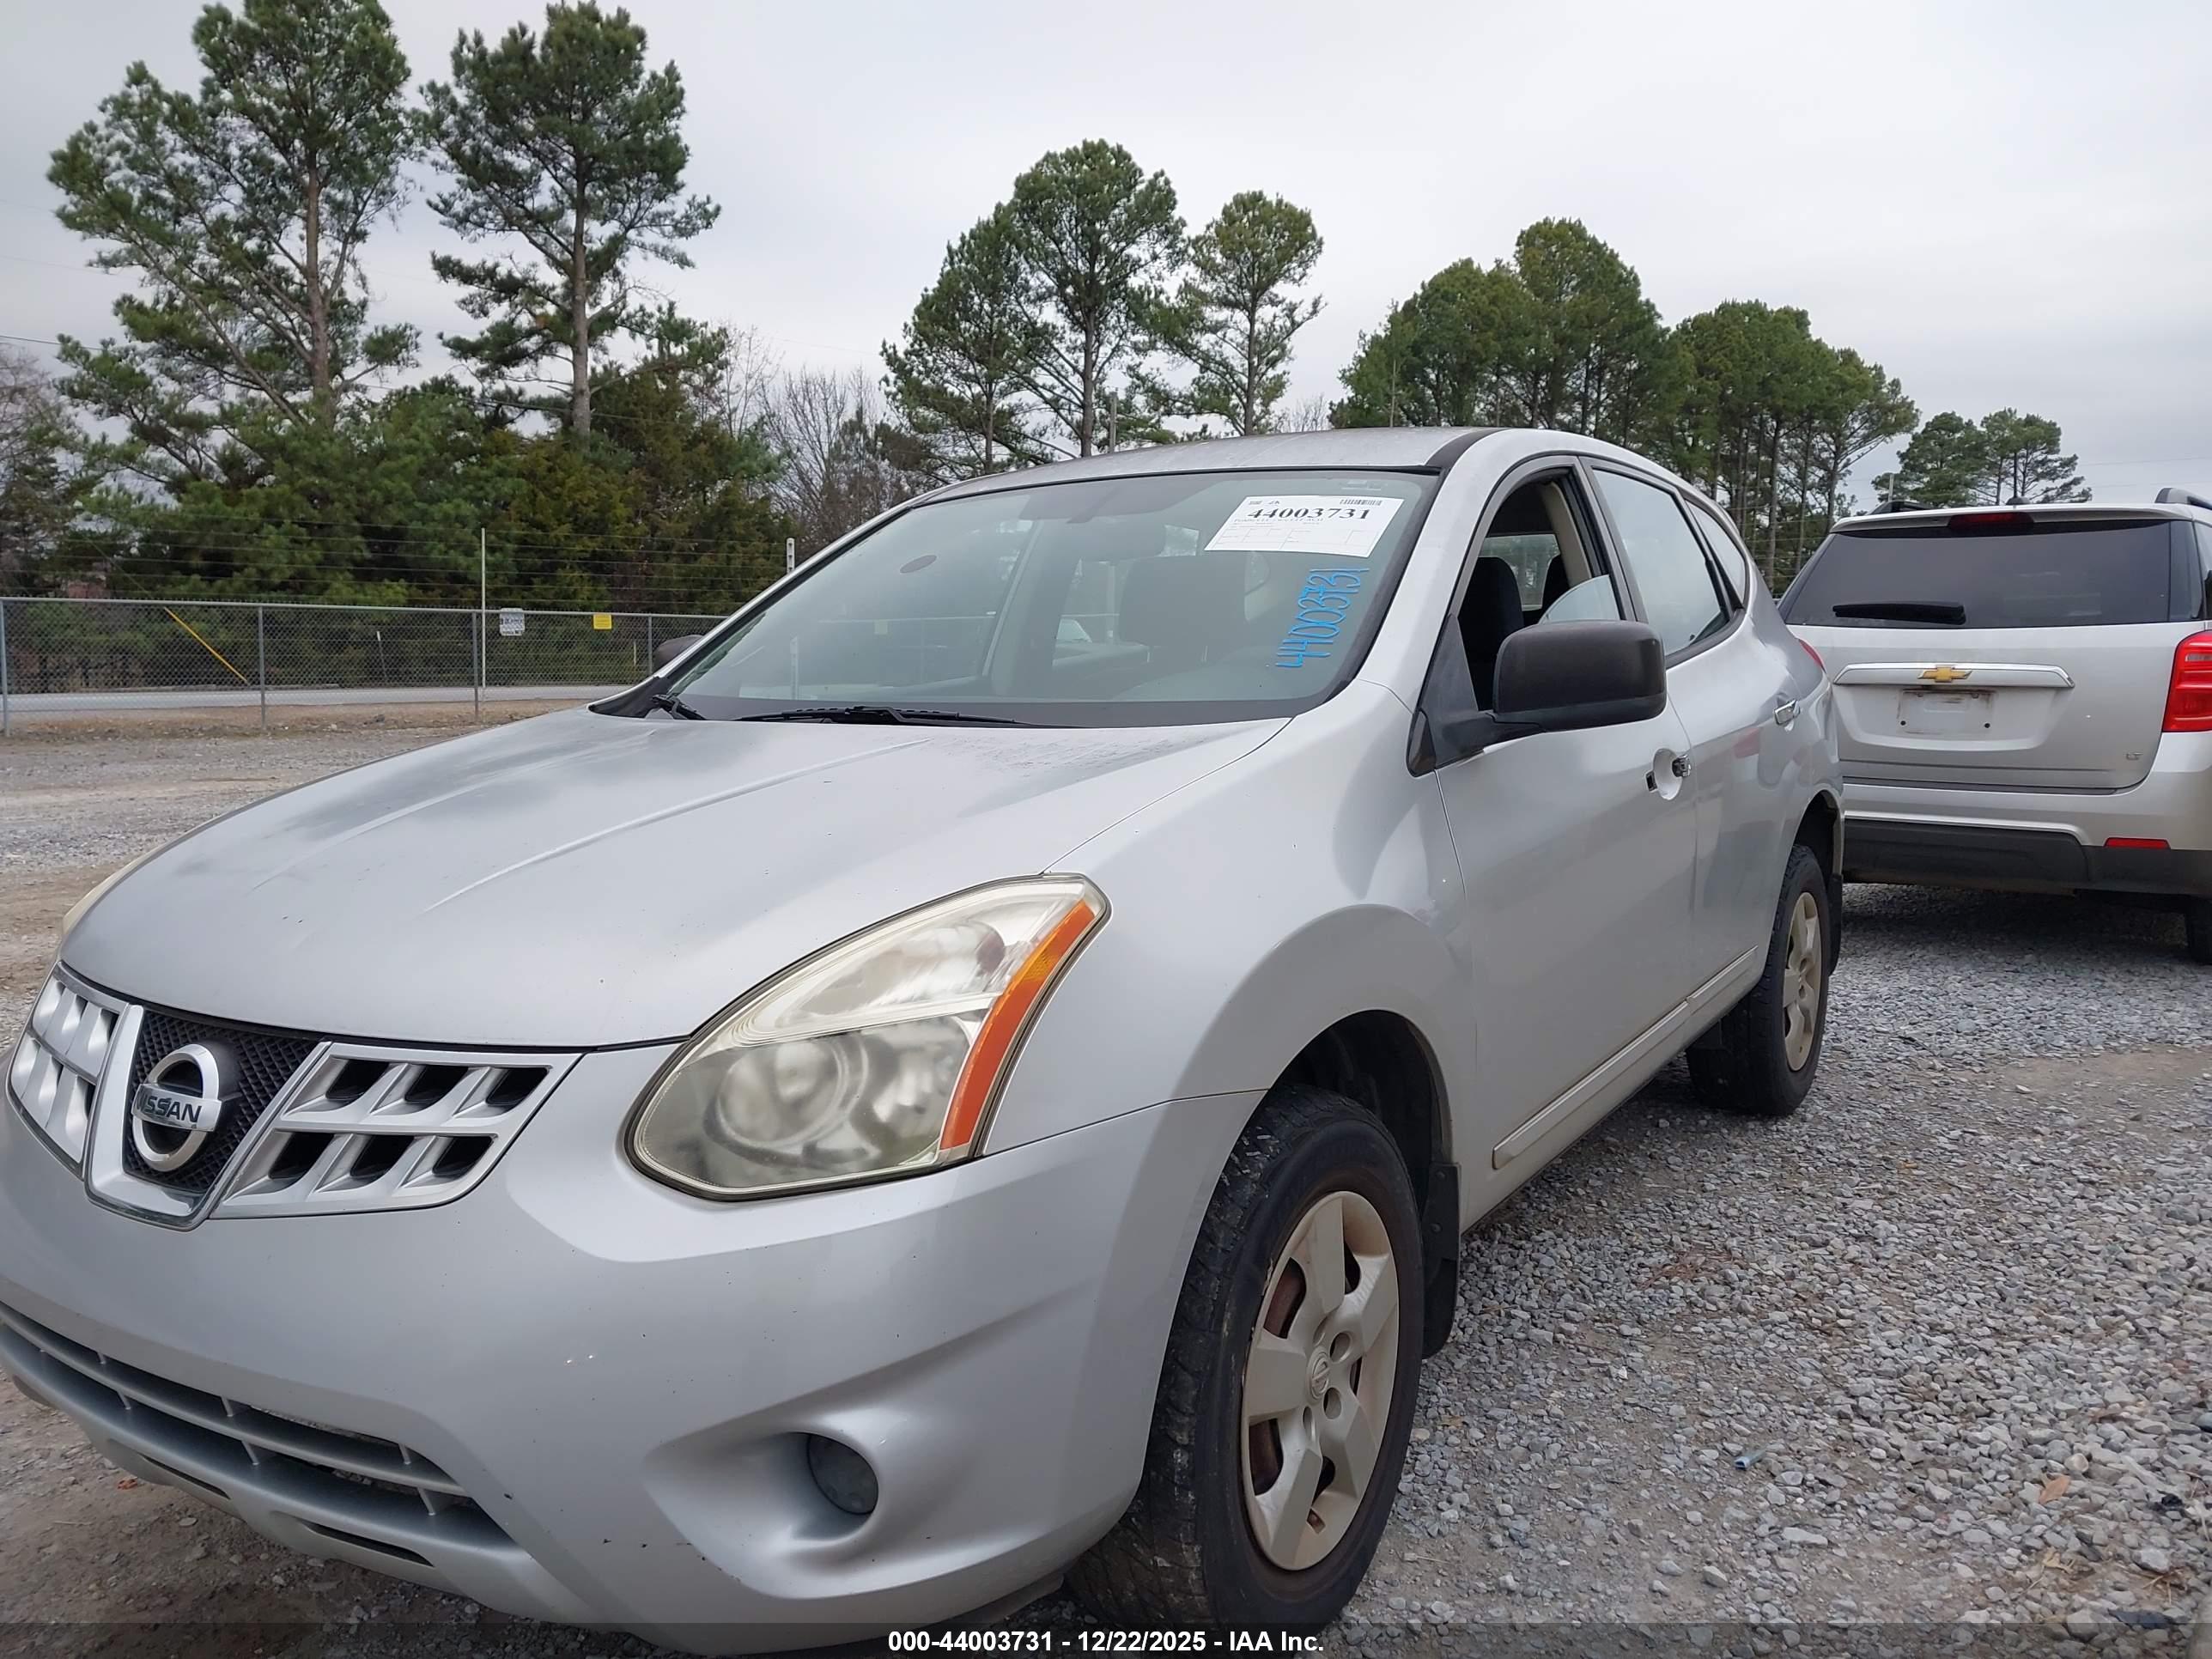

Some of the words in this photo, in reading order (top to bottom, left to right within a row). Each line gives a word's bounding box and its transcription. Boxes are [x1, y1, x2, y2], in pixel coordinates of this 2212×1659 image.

[1248, 507, 1370, 520] 44003731
[1275, 567, 1370, 668] 44003731
[135, 1089, 203, 1123] NISSAN
